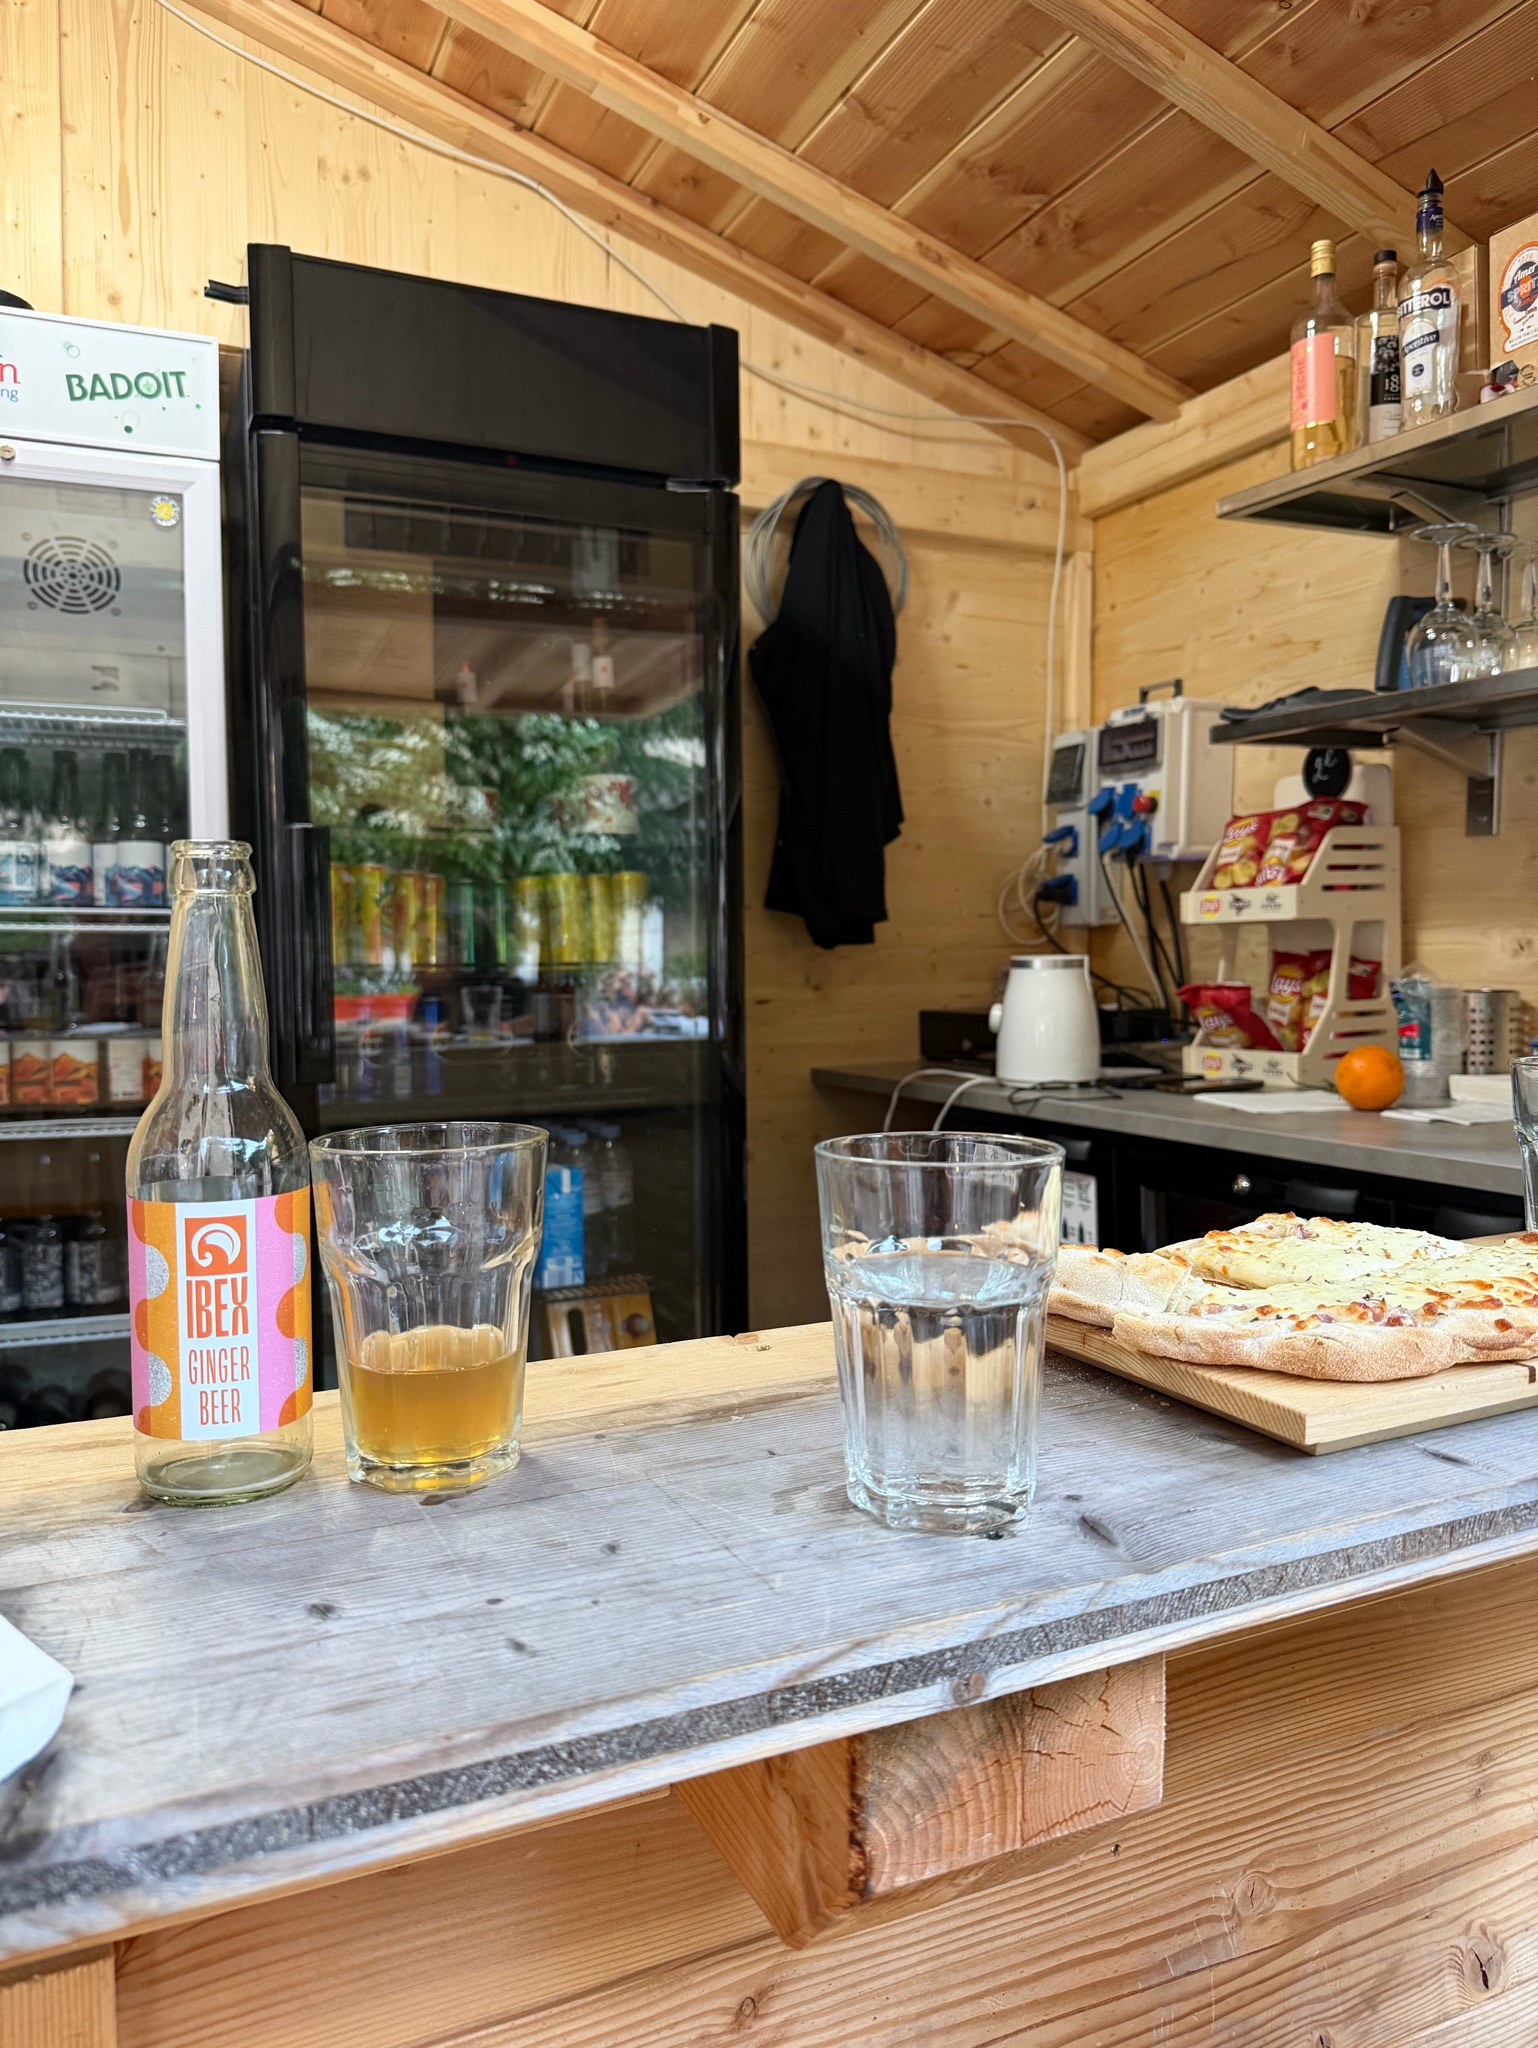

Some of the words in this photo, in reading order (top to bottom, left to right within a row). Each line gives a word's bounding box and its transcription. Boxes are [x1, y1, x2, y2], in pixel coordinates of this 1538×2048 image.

[1507, 276, 1538, 303] SPRIT
[1513, 263, 1537, 285] Amer
[65, 371, 187, 401] BADOIT
[186, 1275, 249, 1339] IBEX
[188, 1345, 250, 1386] GINGER
[199, 1388, 242, 1426] BEER
